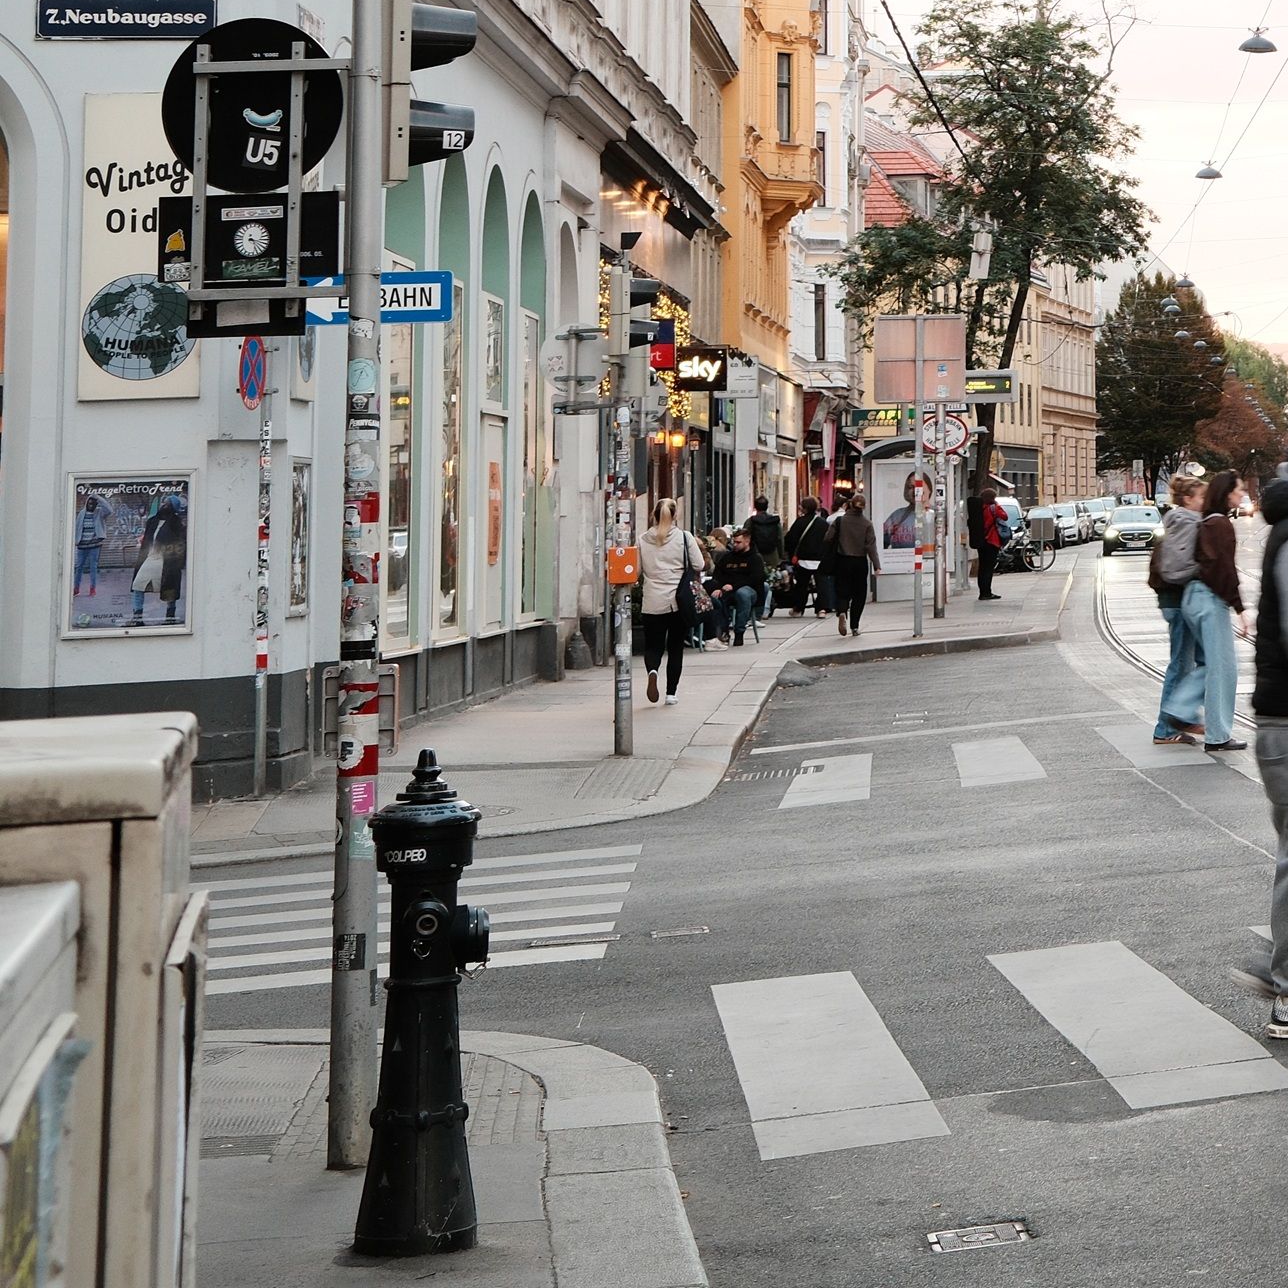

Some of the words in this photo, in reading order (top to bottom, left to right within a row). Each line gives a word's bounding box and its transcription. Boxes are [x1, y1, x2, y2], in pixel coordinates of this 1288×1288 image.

[65, 8, 208, 28] Neubaugasse
[245, 137, 281, 166] U5
[447, 132, 464, 148] 12
[85, 159, 190, 197] Vintag
[678, 355, 722, 382] sky
